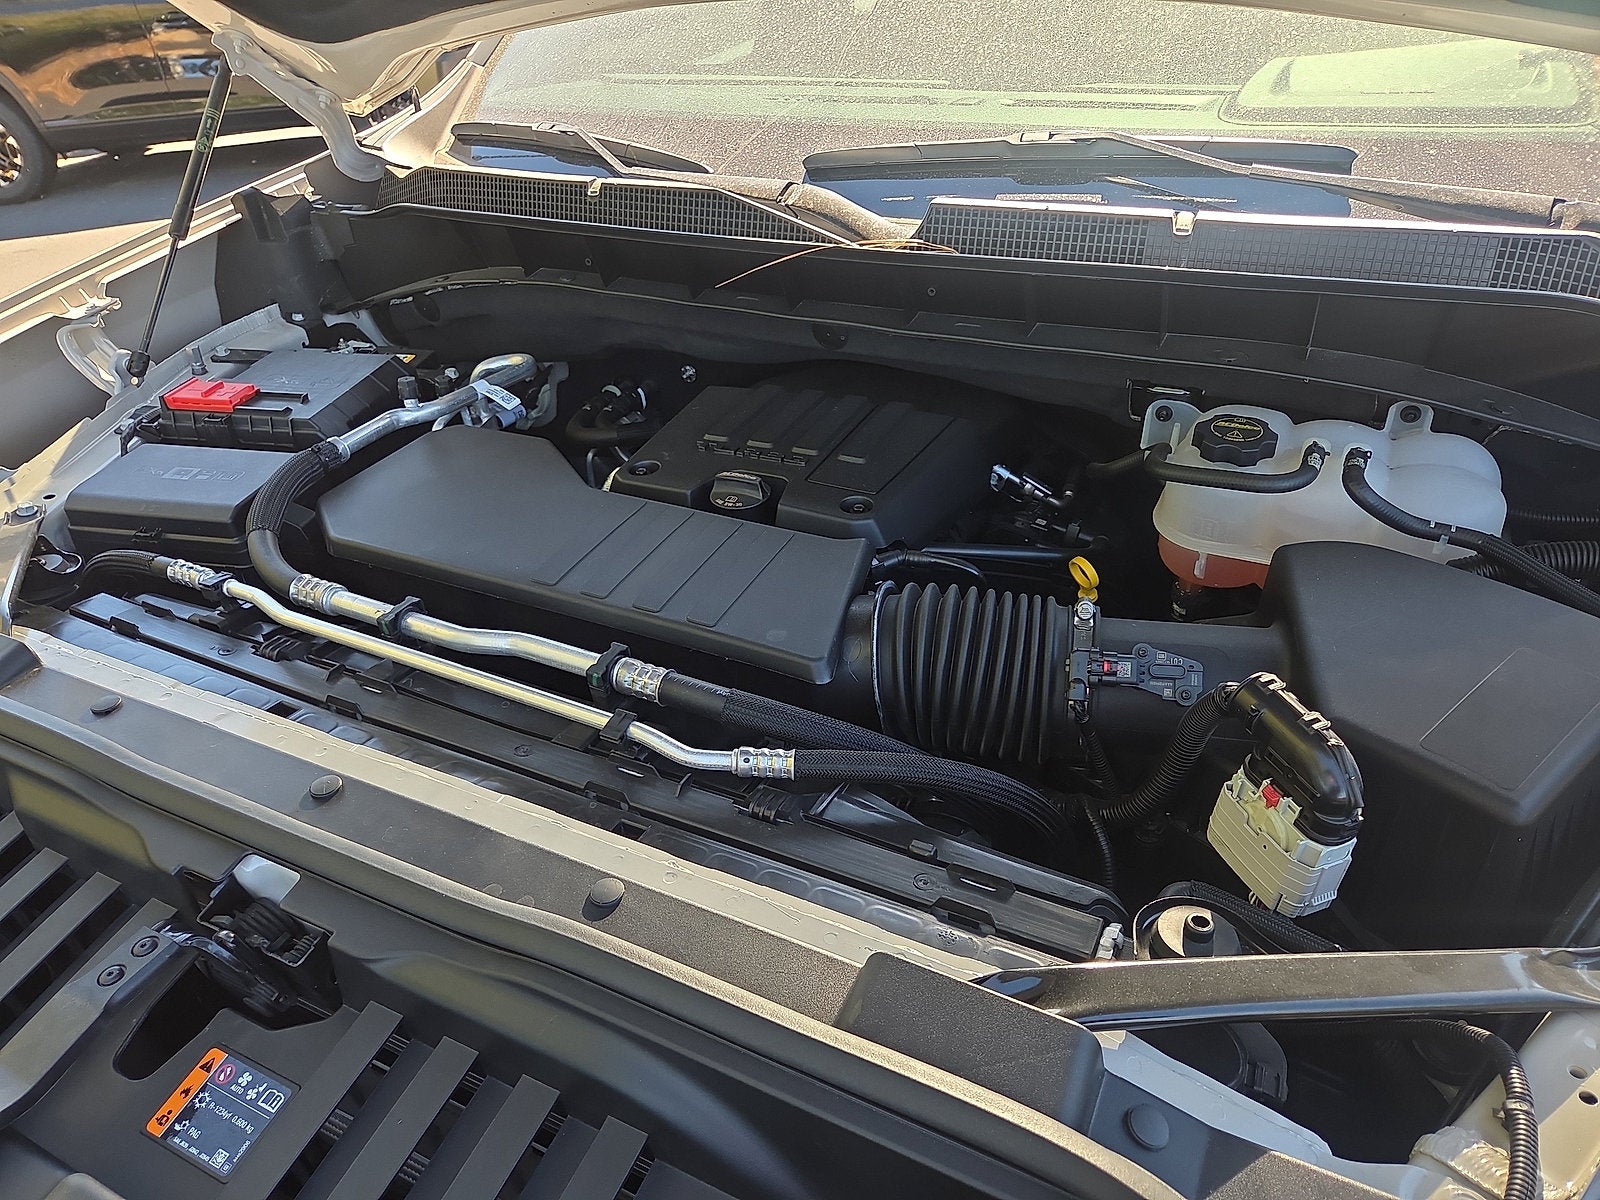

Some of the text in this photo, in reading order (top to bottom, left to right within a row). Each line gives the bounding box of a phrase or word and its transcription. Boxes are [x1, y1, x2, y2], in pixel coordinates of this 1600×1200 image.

[230, 1083, 245, 1095] AUTO
[208, 1101, 233, 1120] R-1234yf
[245, 1123, 255, 1135] kg
[187, 1126, 202, 1140] PAG
